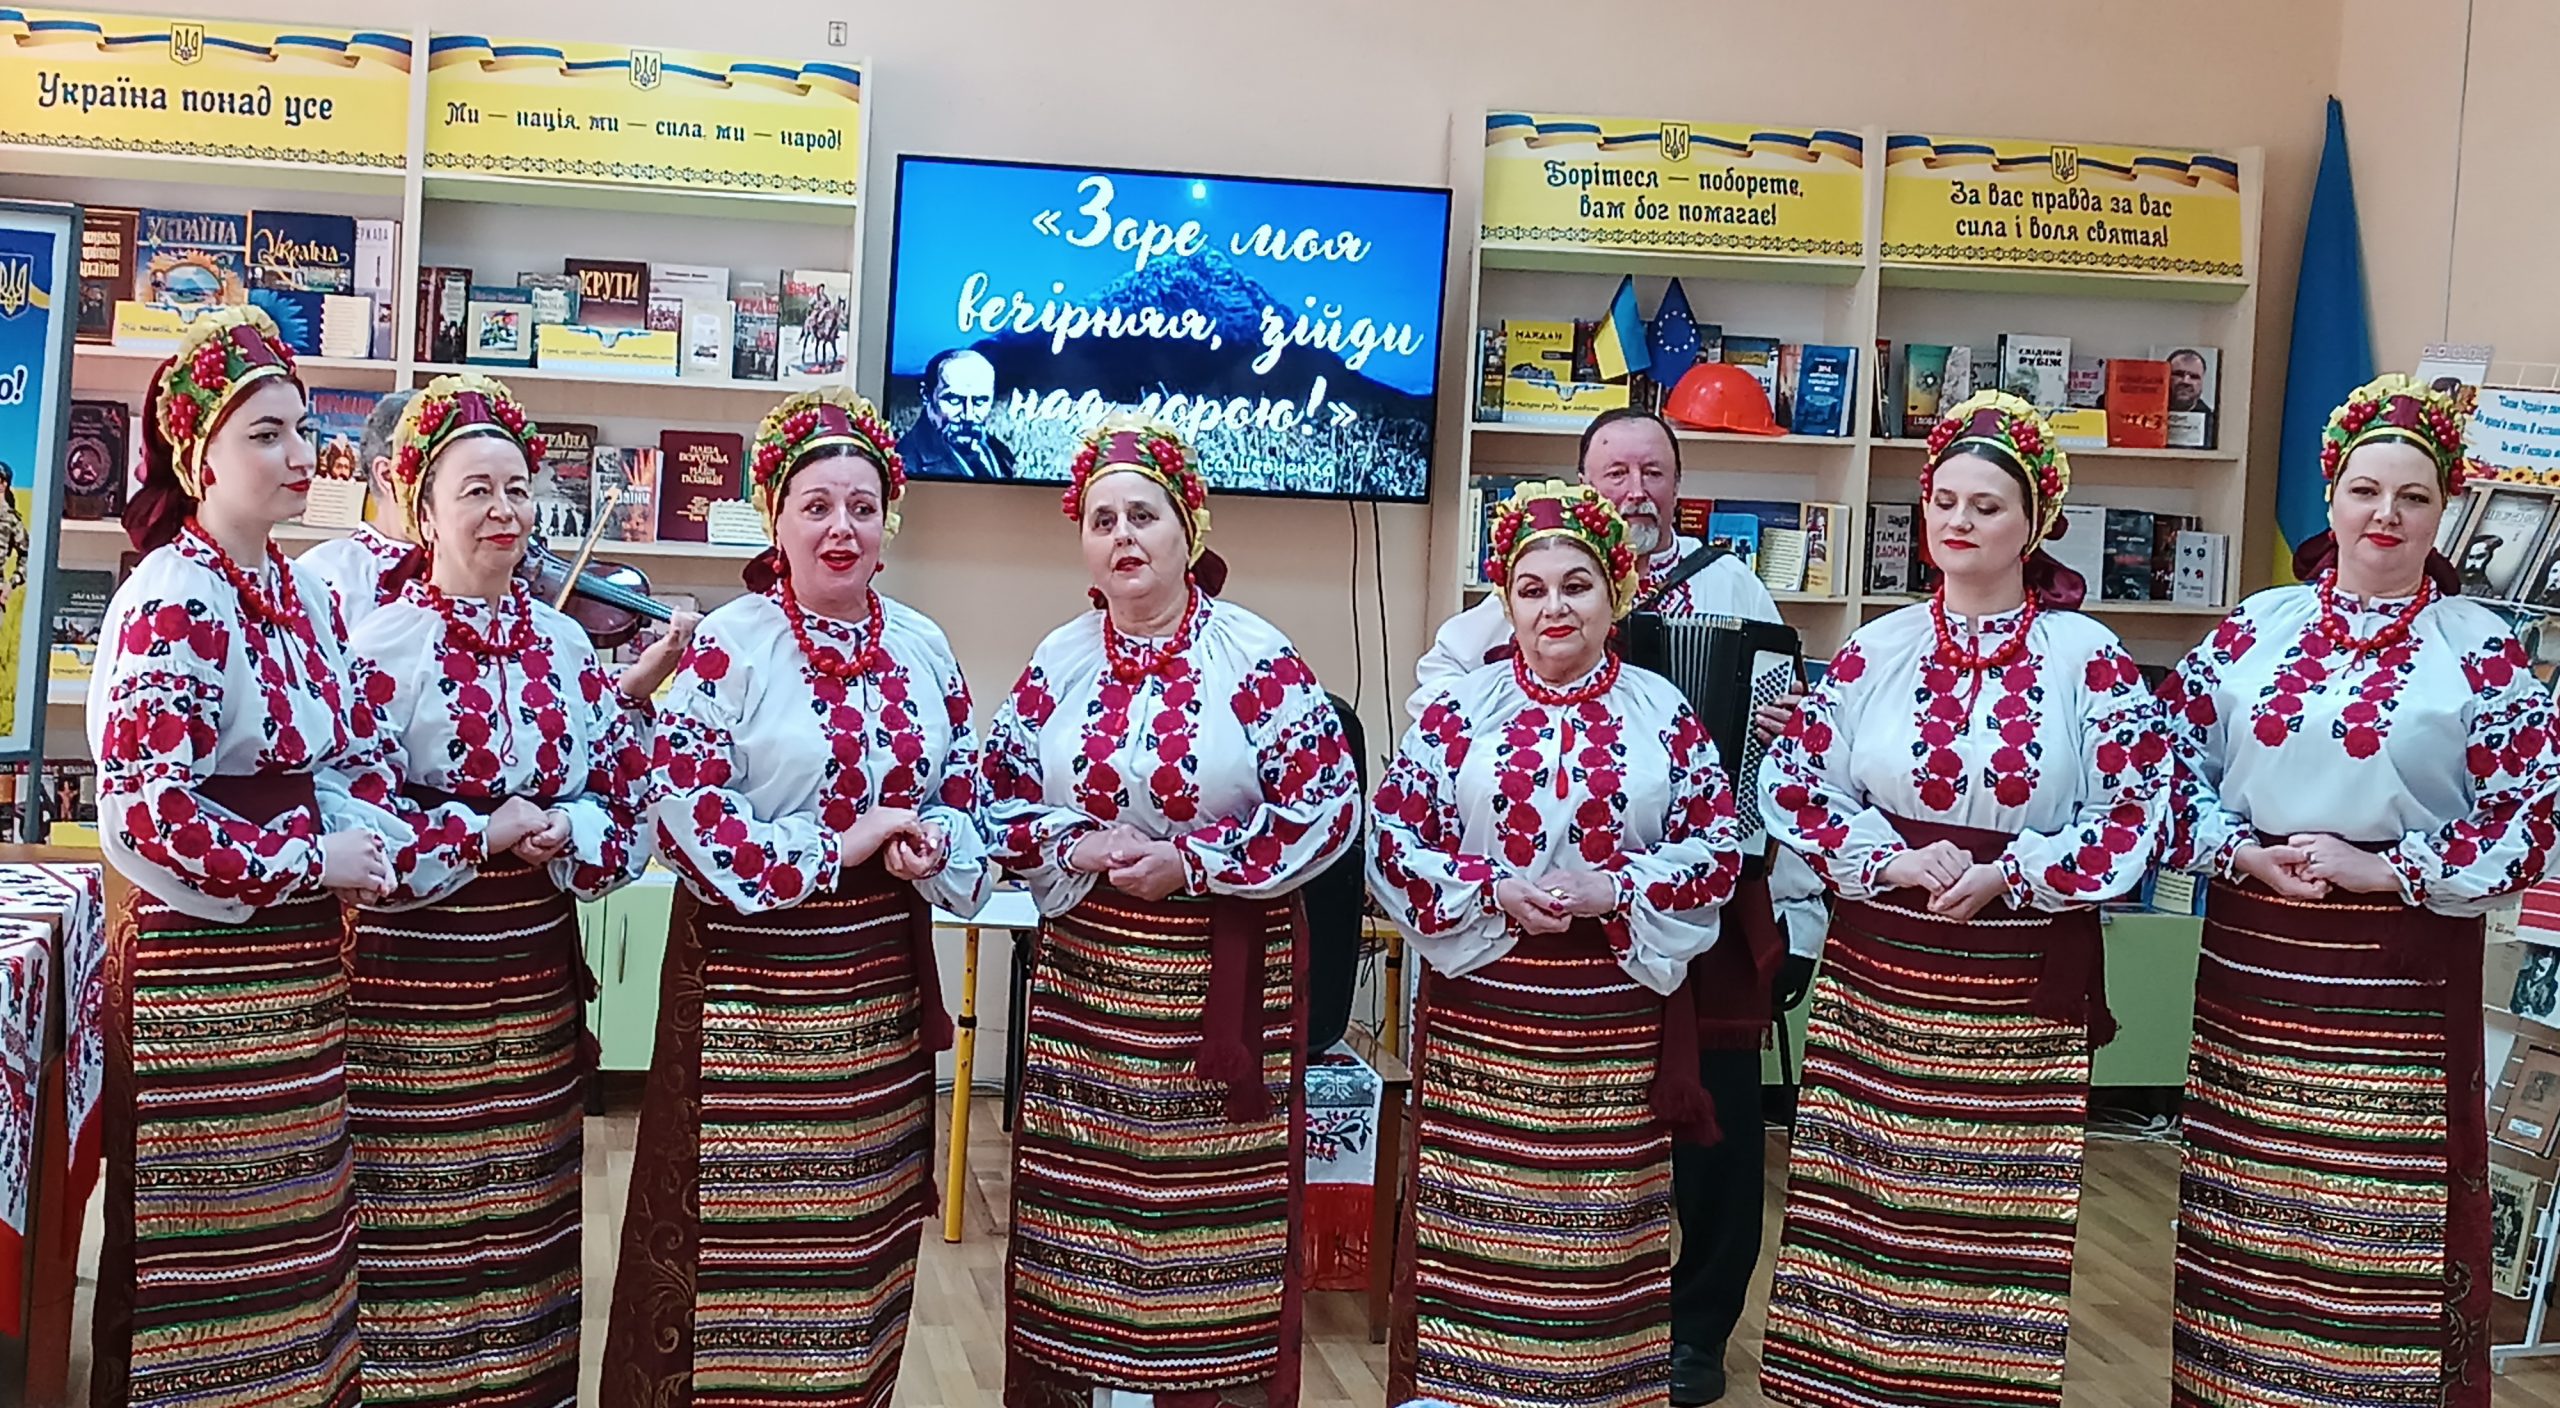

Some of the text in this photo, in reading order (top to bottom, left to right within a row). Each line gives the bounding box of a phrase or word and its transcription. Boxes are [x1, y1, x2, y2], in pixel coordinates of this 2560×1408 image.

[38, 72, 333, 126] Україна понад усе
[445, 102, 479, 126] Ми
[589, 116, 619, 132] ми
[716, 125, 745, 142] ми
[781, 128, 842, 153] народ!
[1544, 160, 1659, 190] Борітеся
[1579, 194, 1777, 226] вам бог помагає!
[1950, 180, 2172, 217] За вас правда за вас
[146, 214, 238, 245] УКРАЇНА
[1032, 176, 1372, 271] «Зоре моя
[1956, 214, 2169, 248] сила і воля святая!
[579, 269, 639, 300] КРУТИ
[957, 271, 1426, 374] вечірняя, зійди
[1008, 387, 1116, 438] над
